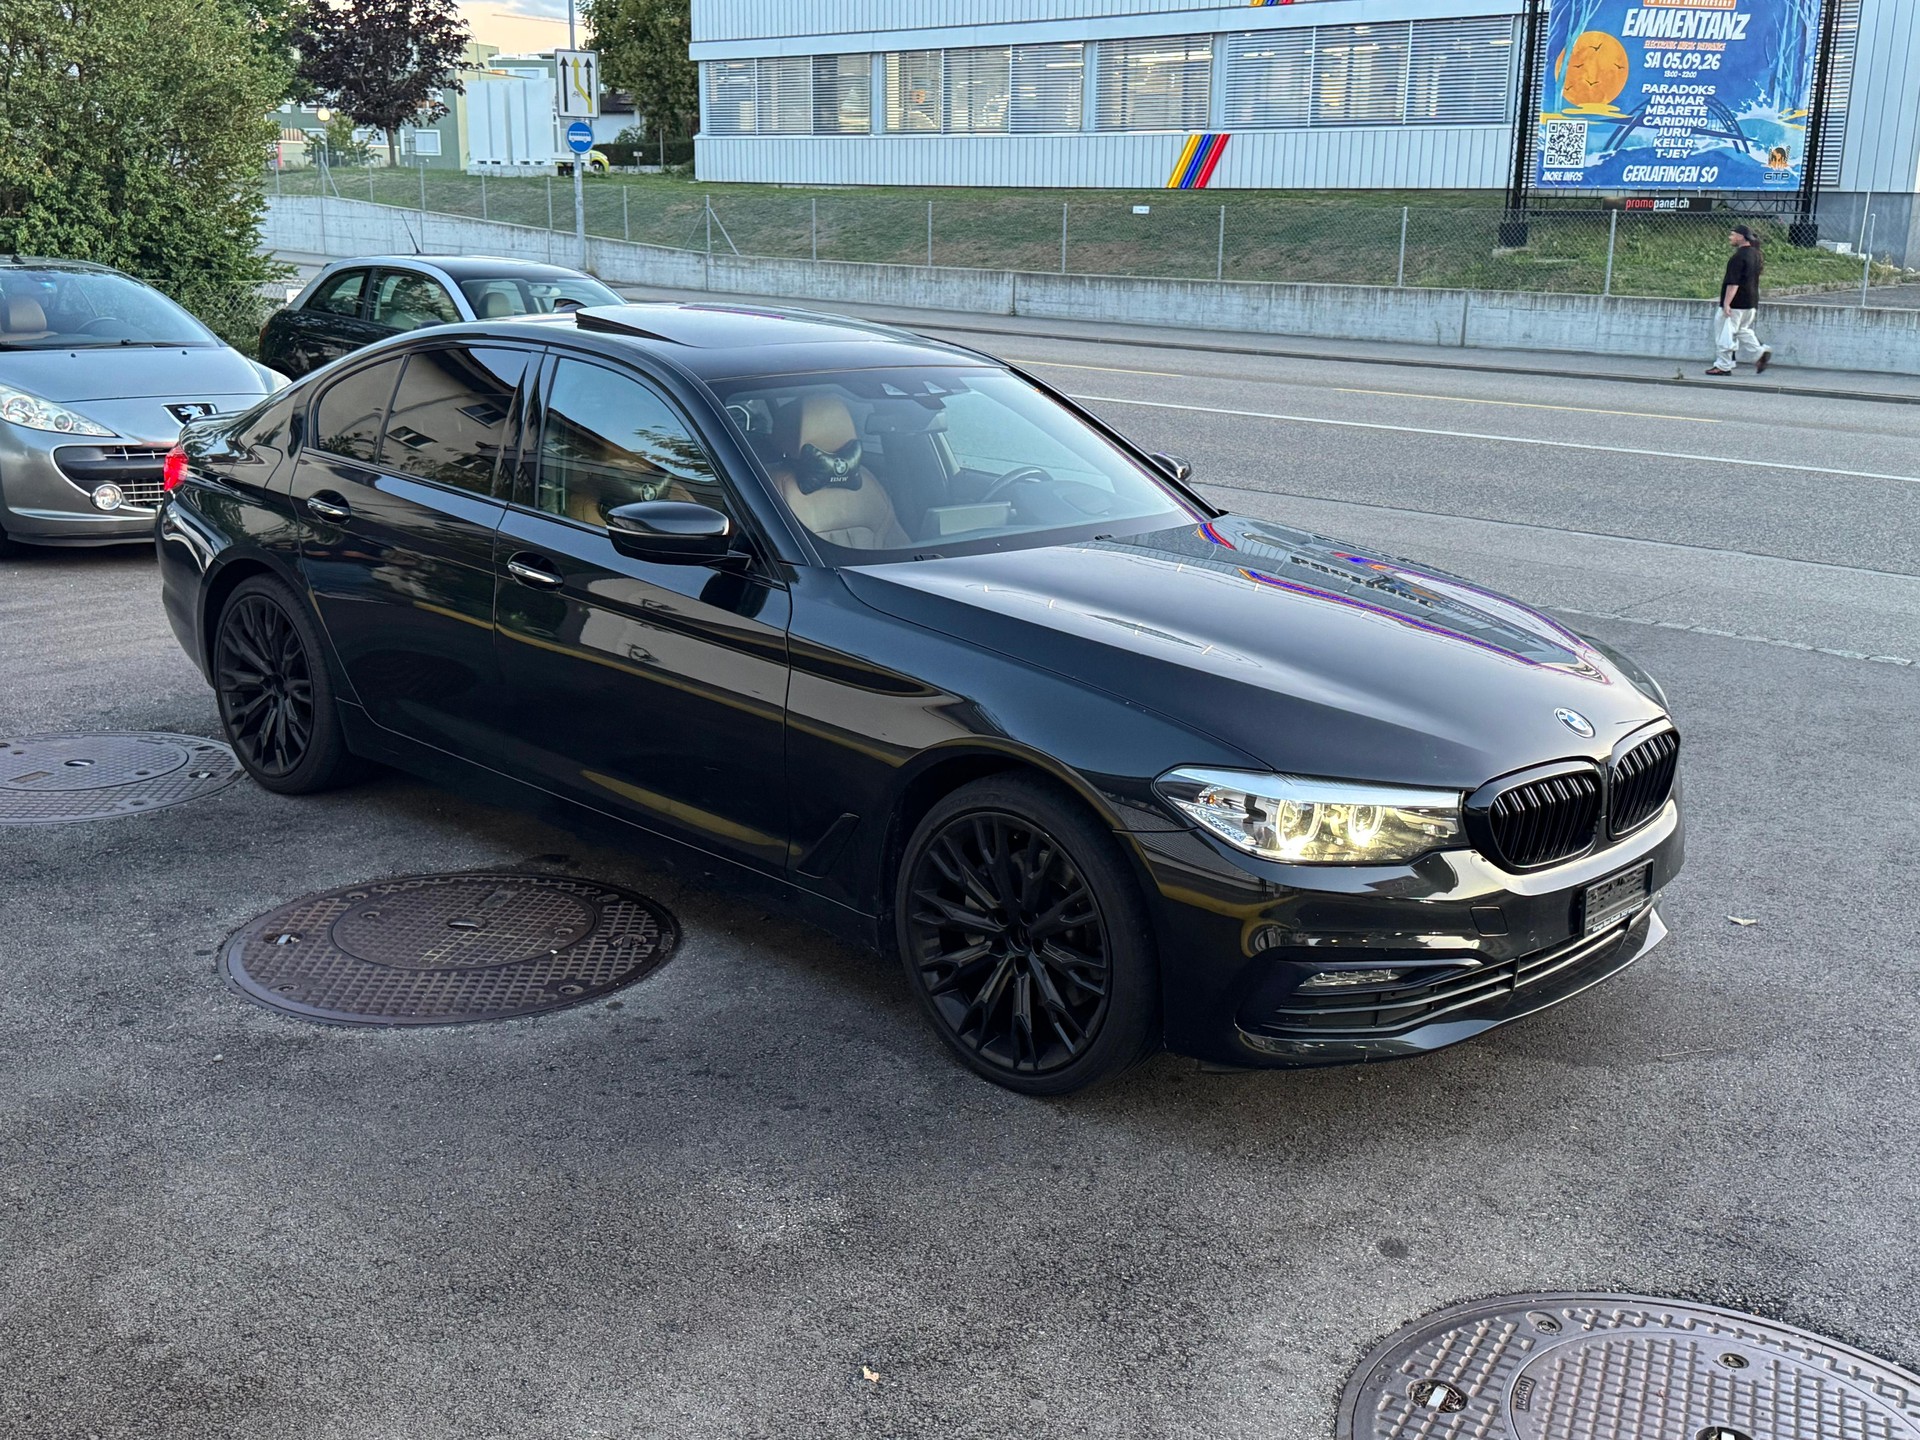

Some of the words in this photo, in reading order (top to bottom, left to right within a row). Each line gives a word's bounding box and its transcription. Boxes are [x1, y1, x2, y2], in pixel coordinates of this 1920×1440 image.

[1621, 8, 1751, 40] EMMENTANZ
[1643, 51, 1661, 68] SA
[1662, 52, 1721, 70] 05.09.26
[1641, 83, 1716, 95] PARADOKS
[1650, 94, 1705, 106] INAMAR
[1645, 105, 1709, 116] MBARETE
[1642, 116, 1708, 127] CARIDINO
[1657, 127, 1691, 137] JURU
[1653, 138, 1694, 148] KELLR
[1655, 149, 1691, 159] T-JEY
[1541, 171, 1563, 181] MORE
[1562, 171, 1584, 182] INFOS
[1622, 164, 1701, 183] GERLAFINGEN
[1699, 166, 1719, 183] SO
[1763, 172, 1790, 181] GTP
[1625, 197, 1690, 212] promopanel.ch
